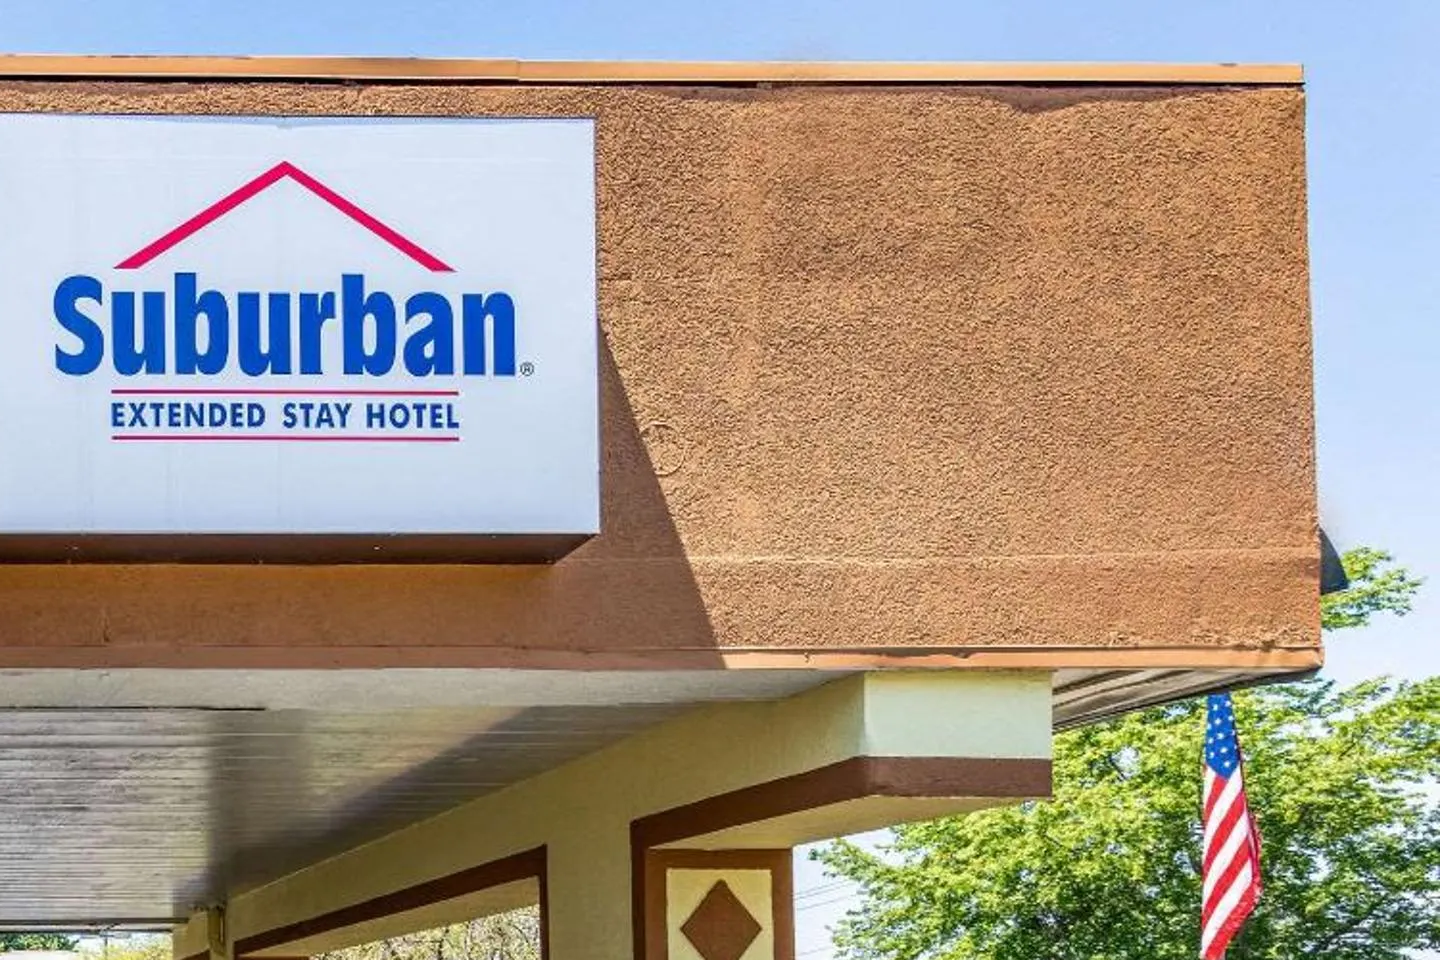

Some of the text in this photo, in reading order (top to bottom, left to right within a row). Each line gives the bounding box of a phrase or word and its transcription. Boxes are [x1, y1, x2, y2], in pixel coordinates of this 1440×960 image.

[53, 272, 517, 378] Suburban
[110, 402, 460, 429] EXTENDED STAY HOTEL
